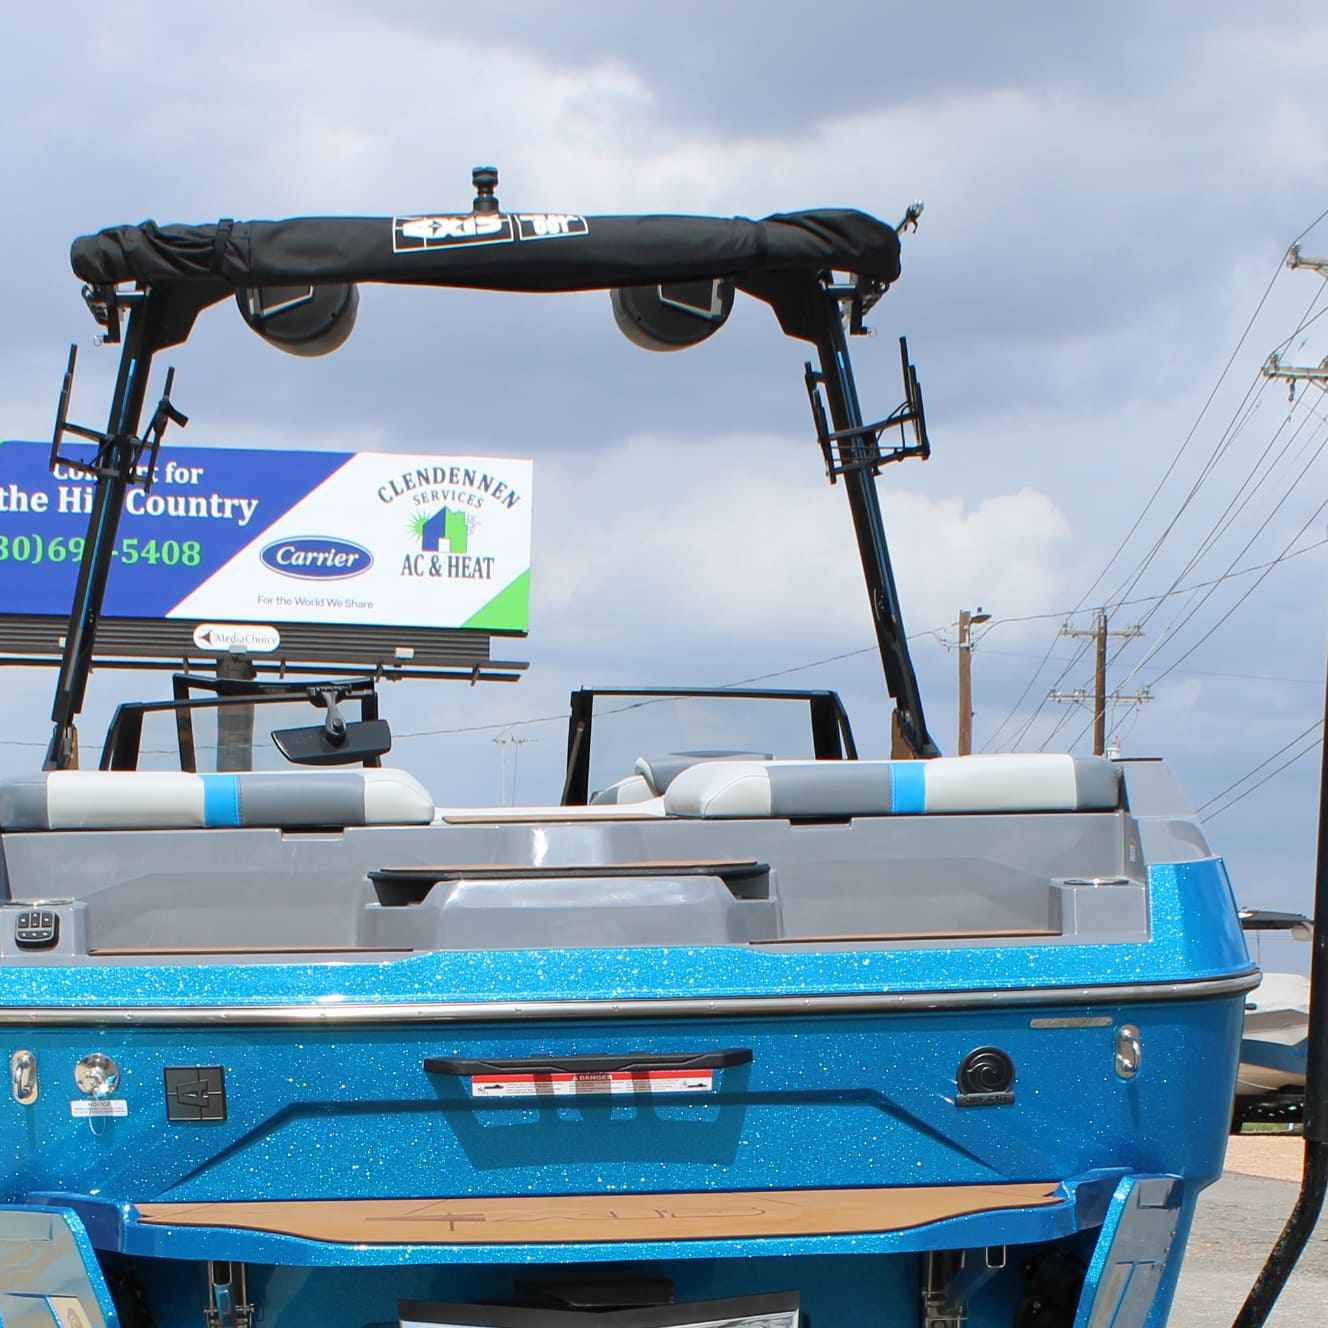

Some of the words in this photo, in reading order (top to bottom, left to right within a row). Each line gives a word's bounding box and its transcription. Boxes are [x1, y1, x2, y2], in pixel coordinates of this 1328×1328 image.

[165, 461, 204, 485] for
[376, 466, 521, 510] CLENDENNEN
[412, 489, 484, 509] SERVICES
[57, 486, 93, 514] Hi
[126, 488, 259, 526] Country
[276, 546, 360, 568] Carrier
[401, 553, 424, 577] AC
[428, 556, 442, 577] &
[447, 555, 495, 580] HEAT
[257, 595, 273, 605] For
[276, 596, 292, 606] the
[294, 597, 324, 608] World
[326, 598, 344, 609] We
[346, 599, 374, 610] Share
